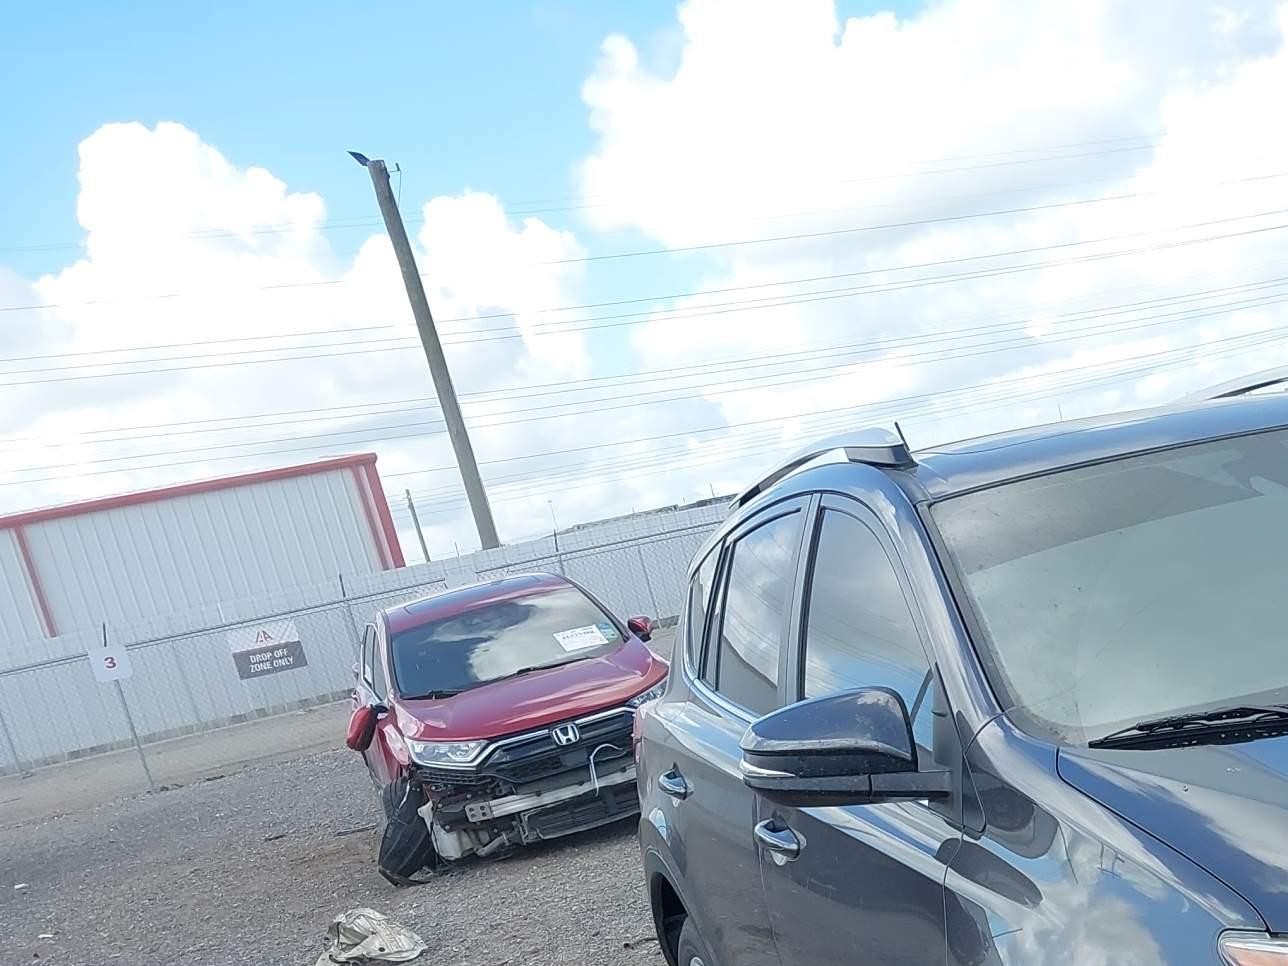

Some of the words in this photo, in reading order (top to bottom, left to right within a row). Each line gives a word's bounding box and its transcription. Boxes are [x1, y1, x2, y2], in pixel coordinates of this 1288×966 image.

[104, 656, 117, 669] 3
[249, 652, 273, 664] DROP
[274, 648, 289, 658] OFF
[249, 661, 273, 673] ZONE
[273, 656, 295, 667] ONLY
